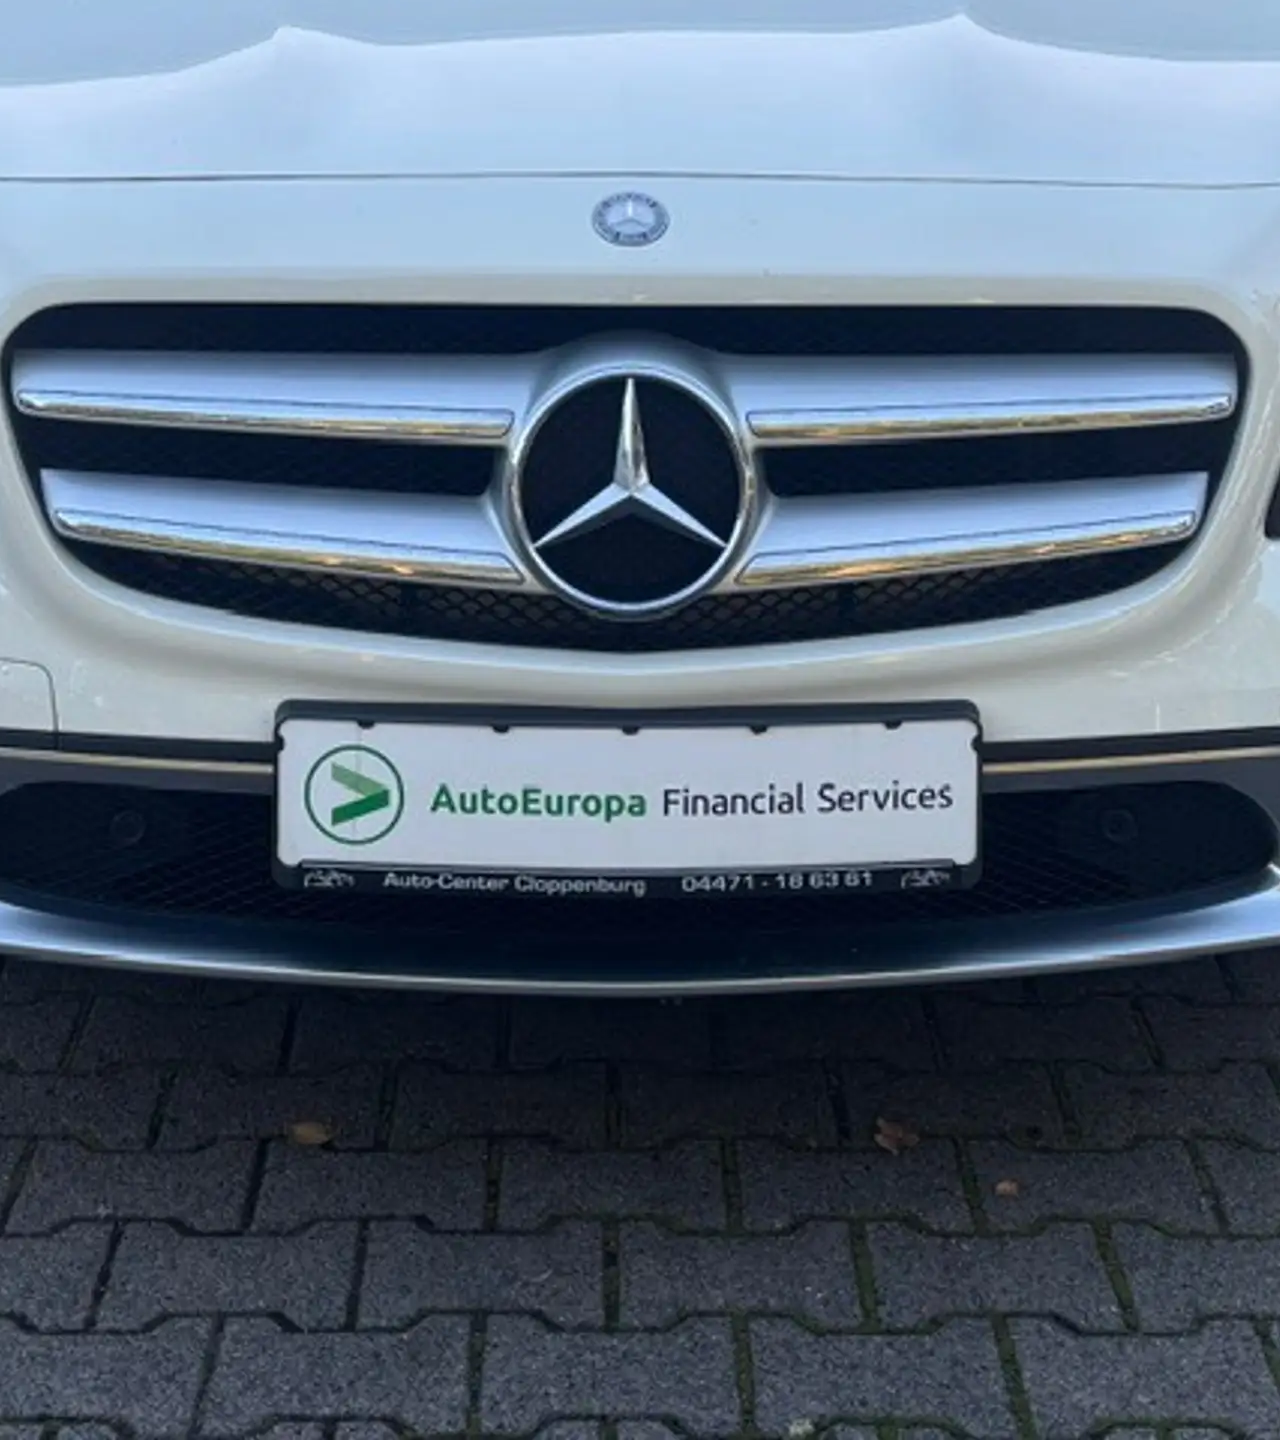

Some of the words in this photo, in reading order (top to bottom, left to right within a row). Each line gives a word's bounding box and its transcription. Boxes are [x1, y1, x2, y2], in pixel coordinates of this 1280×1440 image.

[430, 782, 647, 823] AutoEuropa
[663, 781, 805, 817] Financial
[816, 780, 954, 815] Services
[383, 872, 509, 890] Auto-Center
[514, 875, 647, 898] Cloppenburg
[681, 874, 755, 893] 04471
